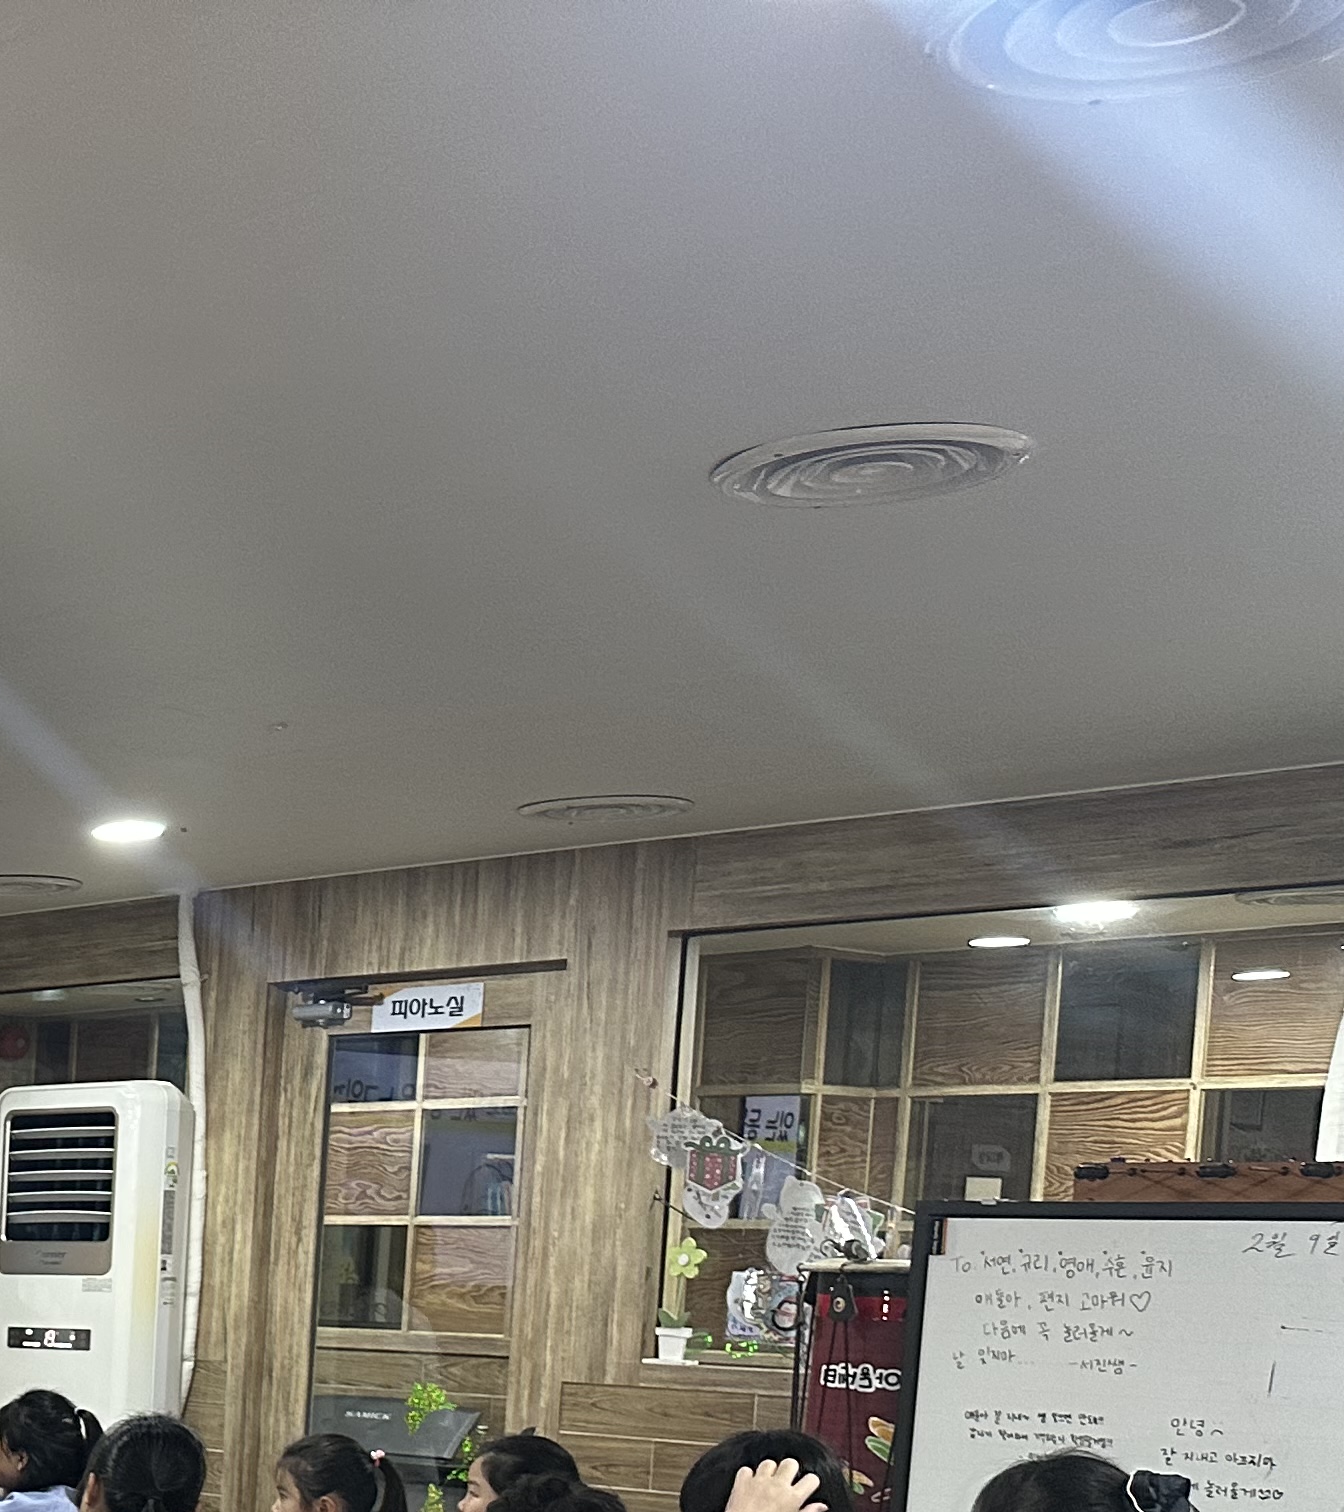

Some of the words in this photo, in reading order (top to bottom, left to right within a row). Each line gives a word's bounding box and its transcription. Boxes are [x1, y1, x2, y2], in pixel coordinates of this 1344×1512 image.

[391, 996, 465, 1020] 피아노실
[1242, 1232, 1296, 1259] 2월
[1309, 1231, 1341, 1257] 9일
[1039, 1291, 1069, 1312] 편지
[1080, 1291, 1125, 1311] 고마워
[983, 1320, 1027, 1340] 다음에
[1171, 1418, 1206, 1437] 안녕
[1161, 1447, 1178, 1466] 잘
[1182, 1451, 1219, 1464] 지내고
[1225, 1453, 1278, 1471] 아프지마
